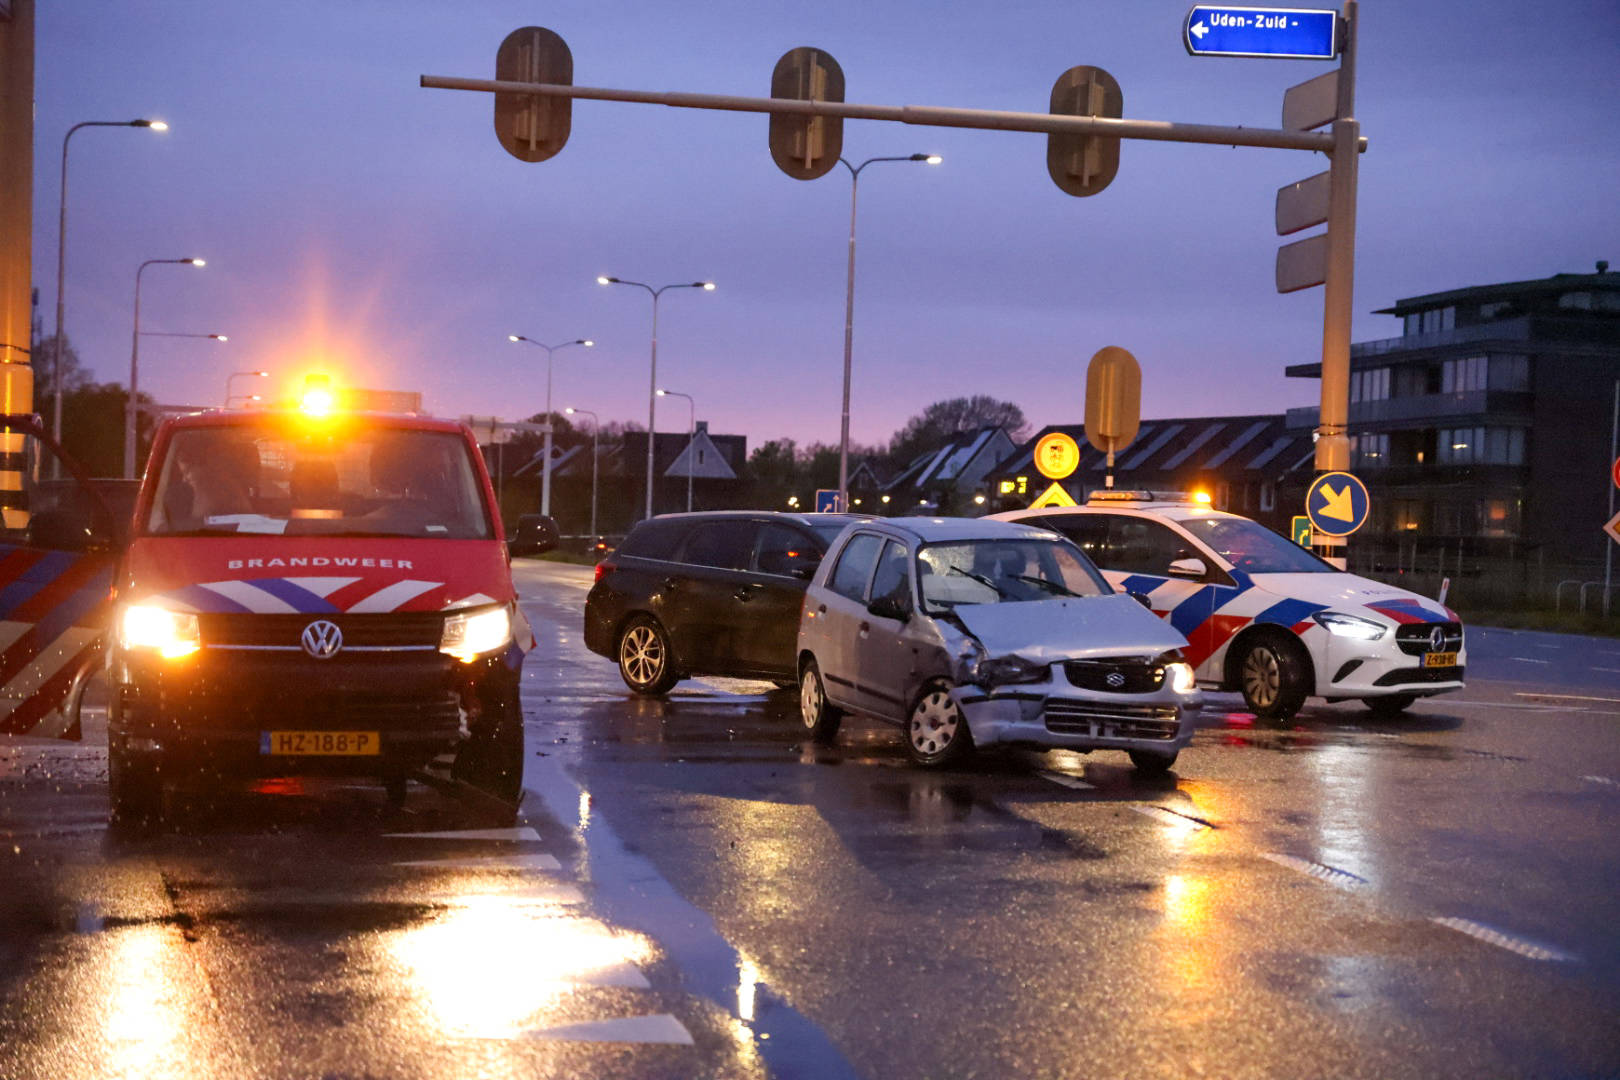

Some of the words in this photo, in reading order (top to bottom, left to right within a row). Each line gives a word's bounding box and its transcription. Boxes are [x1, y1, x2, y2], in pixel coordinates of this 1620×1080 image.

[1210, 13, 1287, 29] Uden-Zuid
[228, 557, 413, 569] BRANDWEER
[280, 734, 369, 752] HZ-188-P
